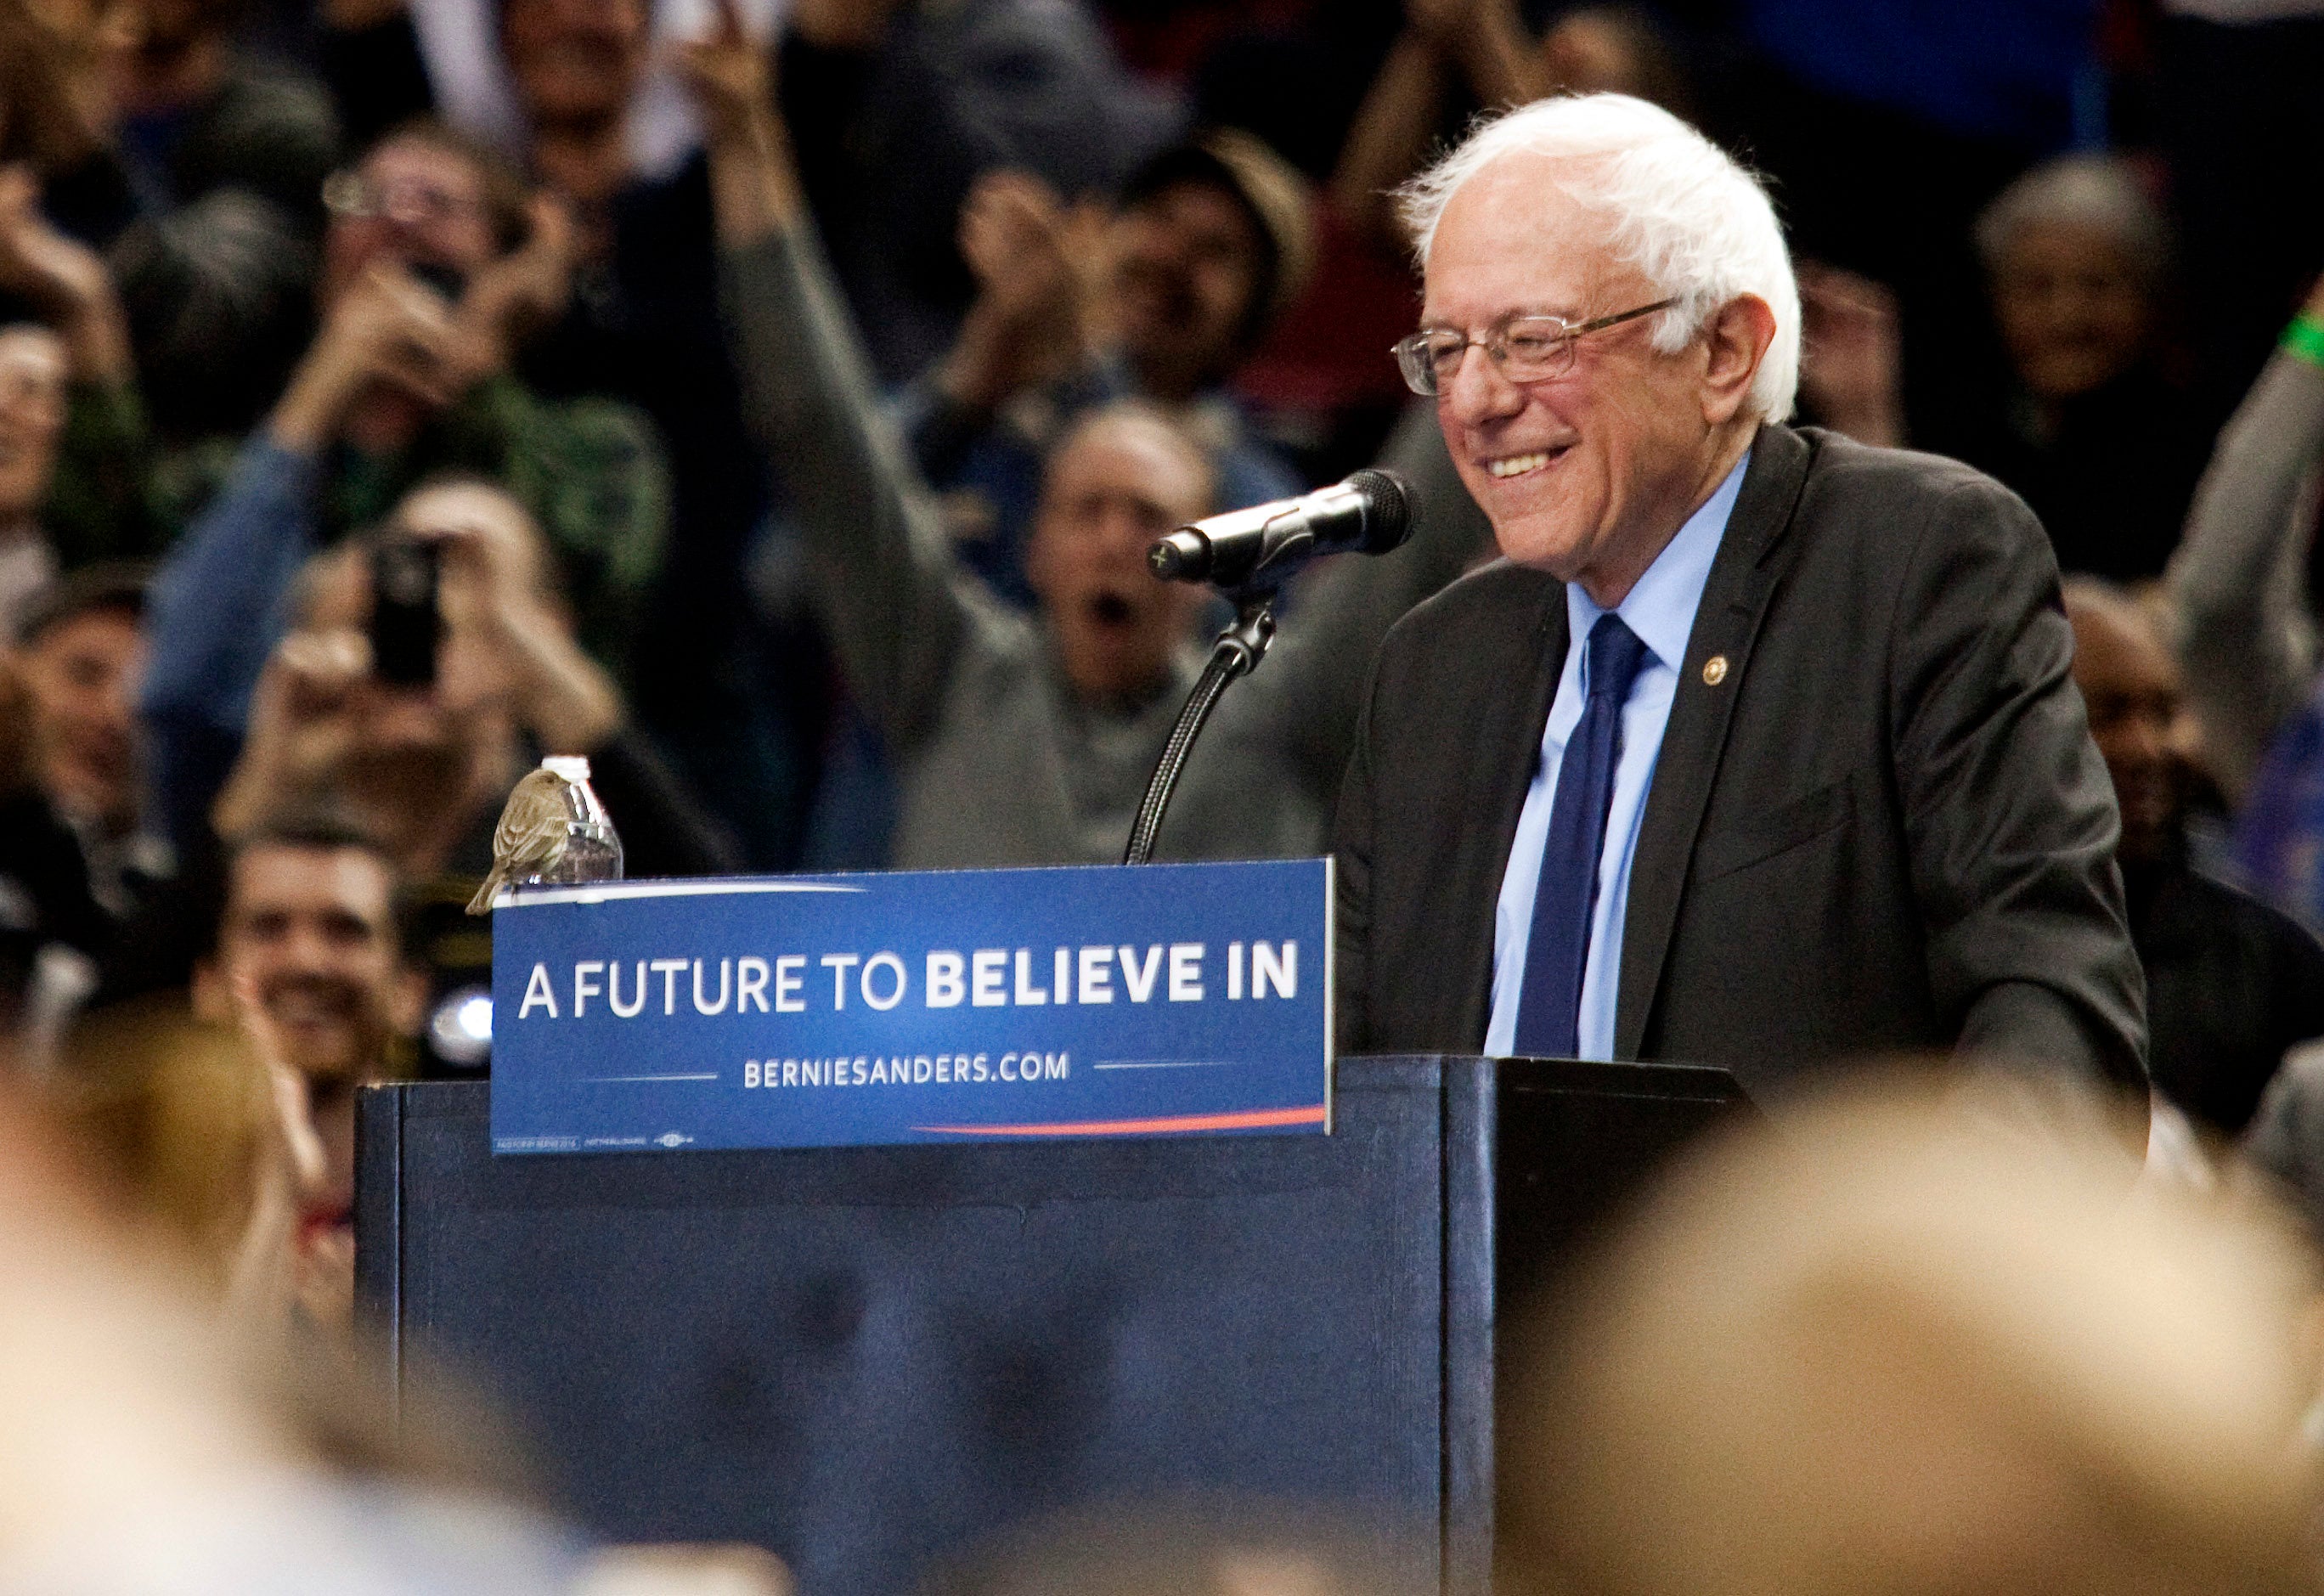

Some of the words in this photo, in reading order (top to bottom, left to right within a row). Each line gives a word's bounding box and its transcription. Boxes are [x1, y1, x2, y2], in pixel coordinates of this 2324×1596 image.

[518, 963, 559, 1018] A
[573, 955, 808, 1018] FUTURE
[820, 950, 909, 1011] TO
[924, 943, 1206, 1008] BELIEVE
[1227, 940, 1299, 1001] IN
[743, 1052, 1069, 1089] BERNIESANDERS.COM
